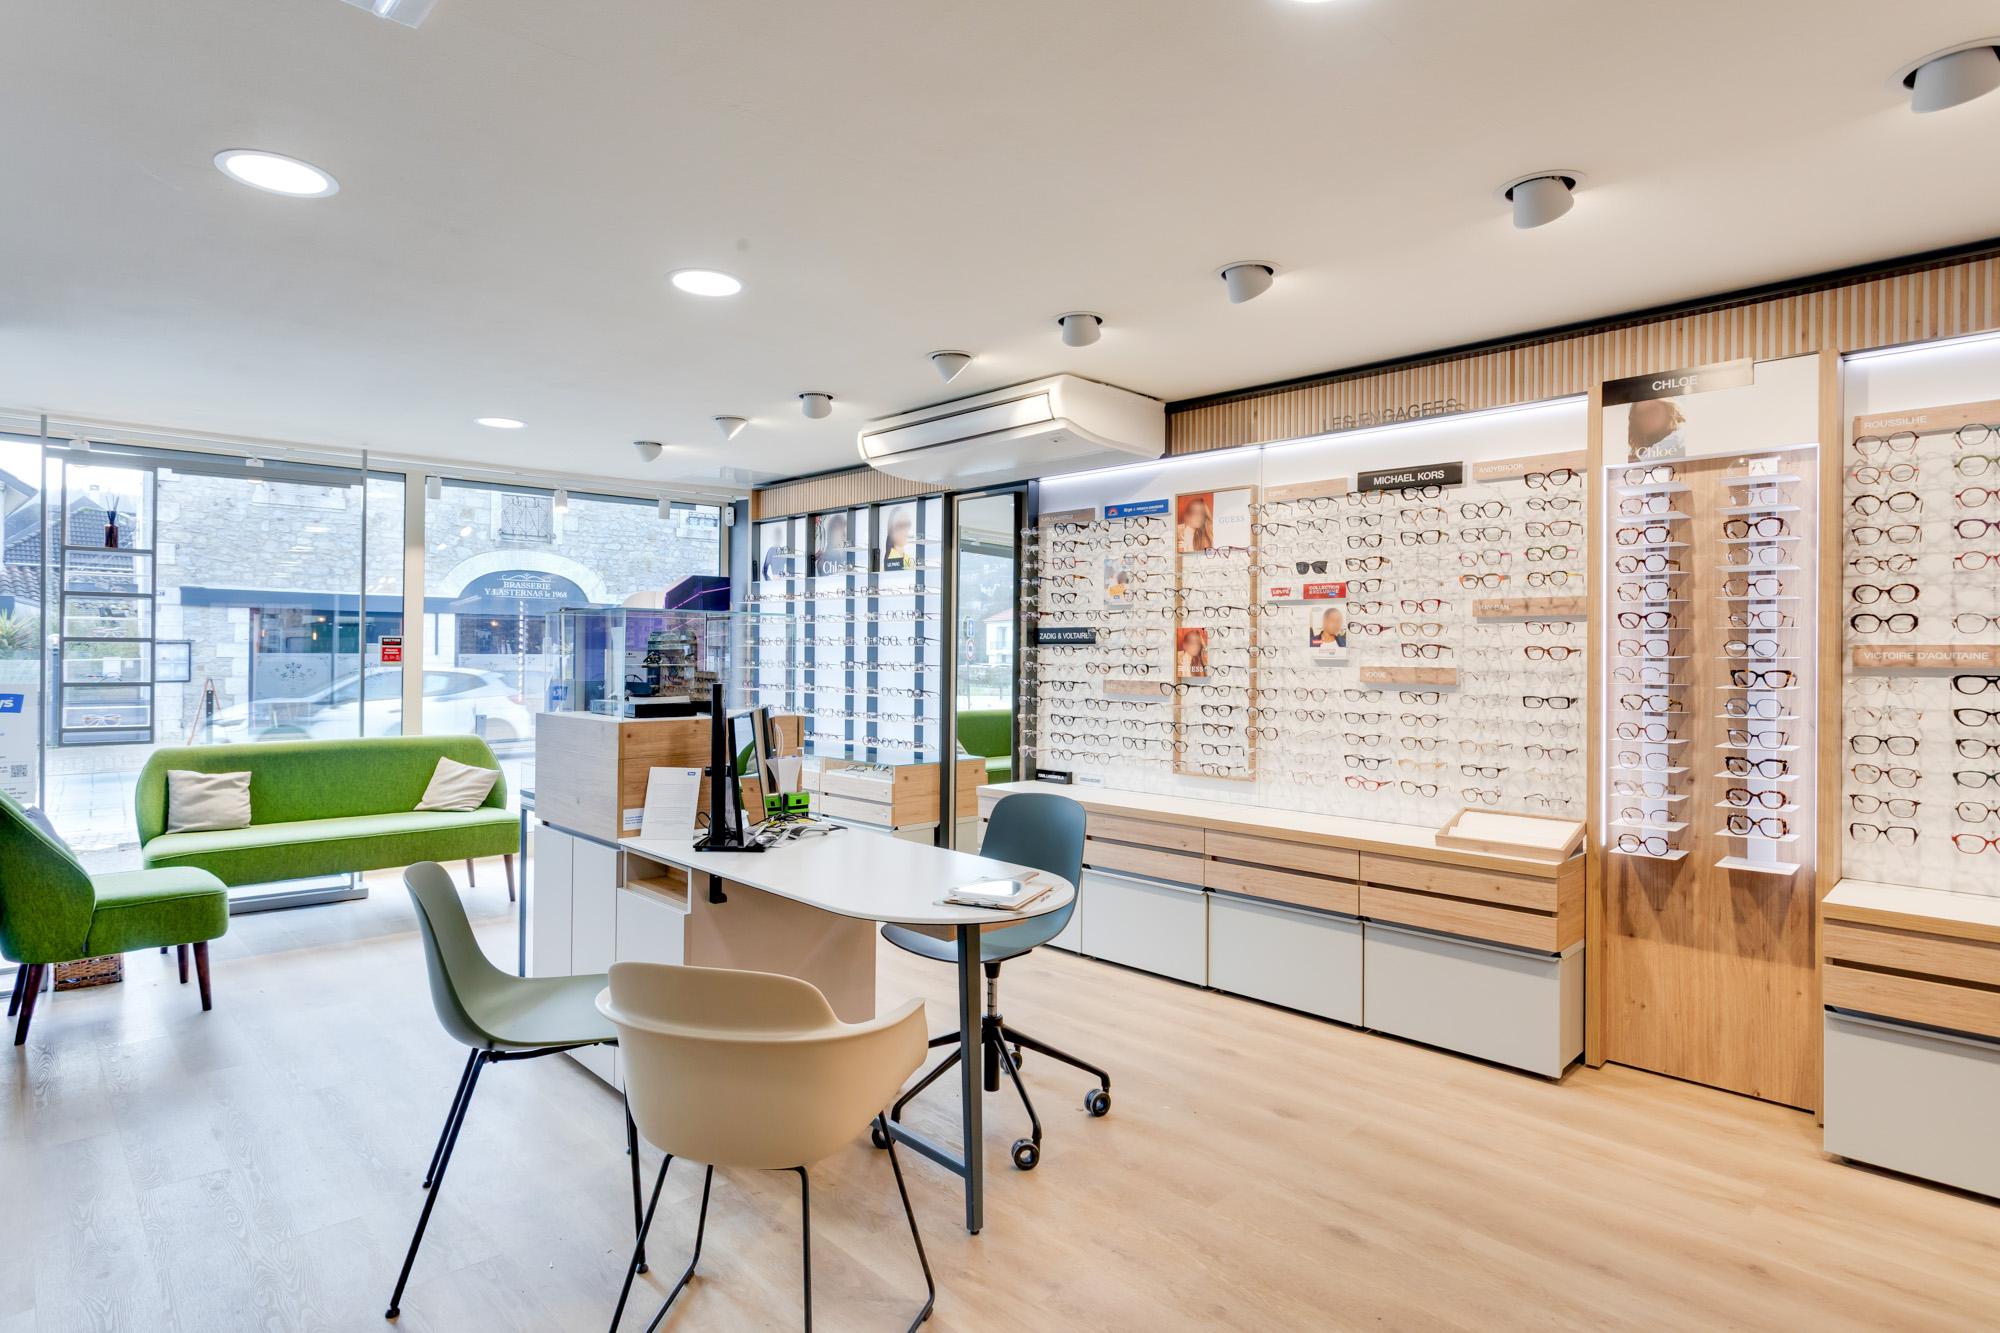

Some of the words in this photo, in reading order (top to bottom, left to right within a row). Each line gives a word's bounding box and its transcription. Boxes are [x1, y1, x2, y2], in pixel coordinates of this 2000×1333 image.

[1652, 374, 1698, 391] CHLOE
[1863, 416, 1928, 429] ROUSSILHE
[1479, 463, 1525, 474] ANDYBROOK
[1373, 473, 1416, 485] MICHAEL
[1417, 470, 1446, 481] KORS
[503, 581, 551, 590] BRASSERIE
[545, 589, 551, 597] le
[552, 591, 568, 599] 1968
[1039, 632, 1057, 640] ZADIG
[1057, 632, 1062, 640] &
[1863, 651, 1916, 660] VICTOIRE
[1918, 651, 1990, 661] D'AQUITAINE
